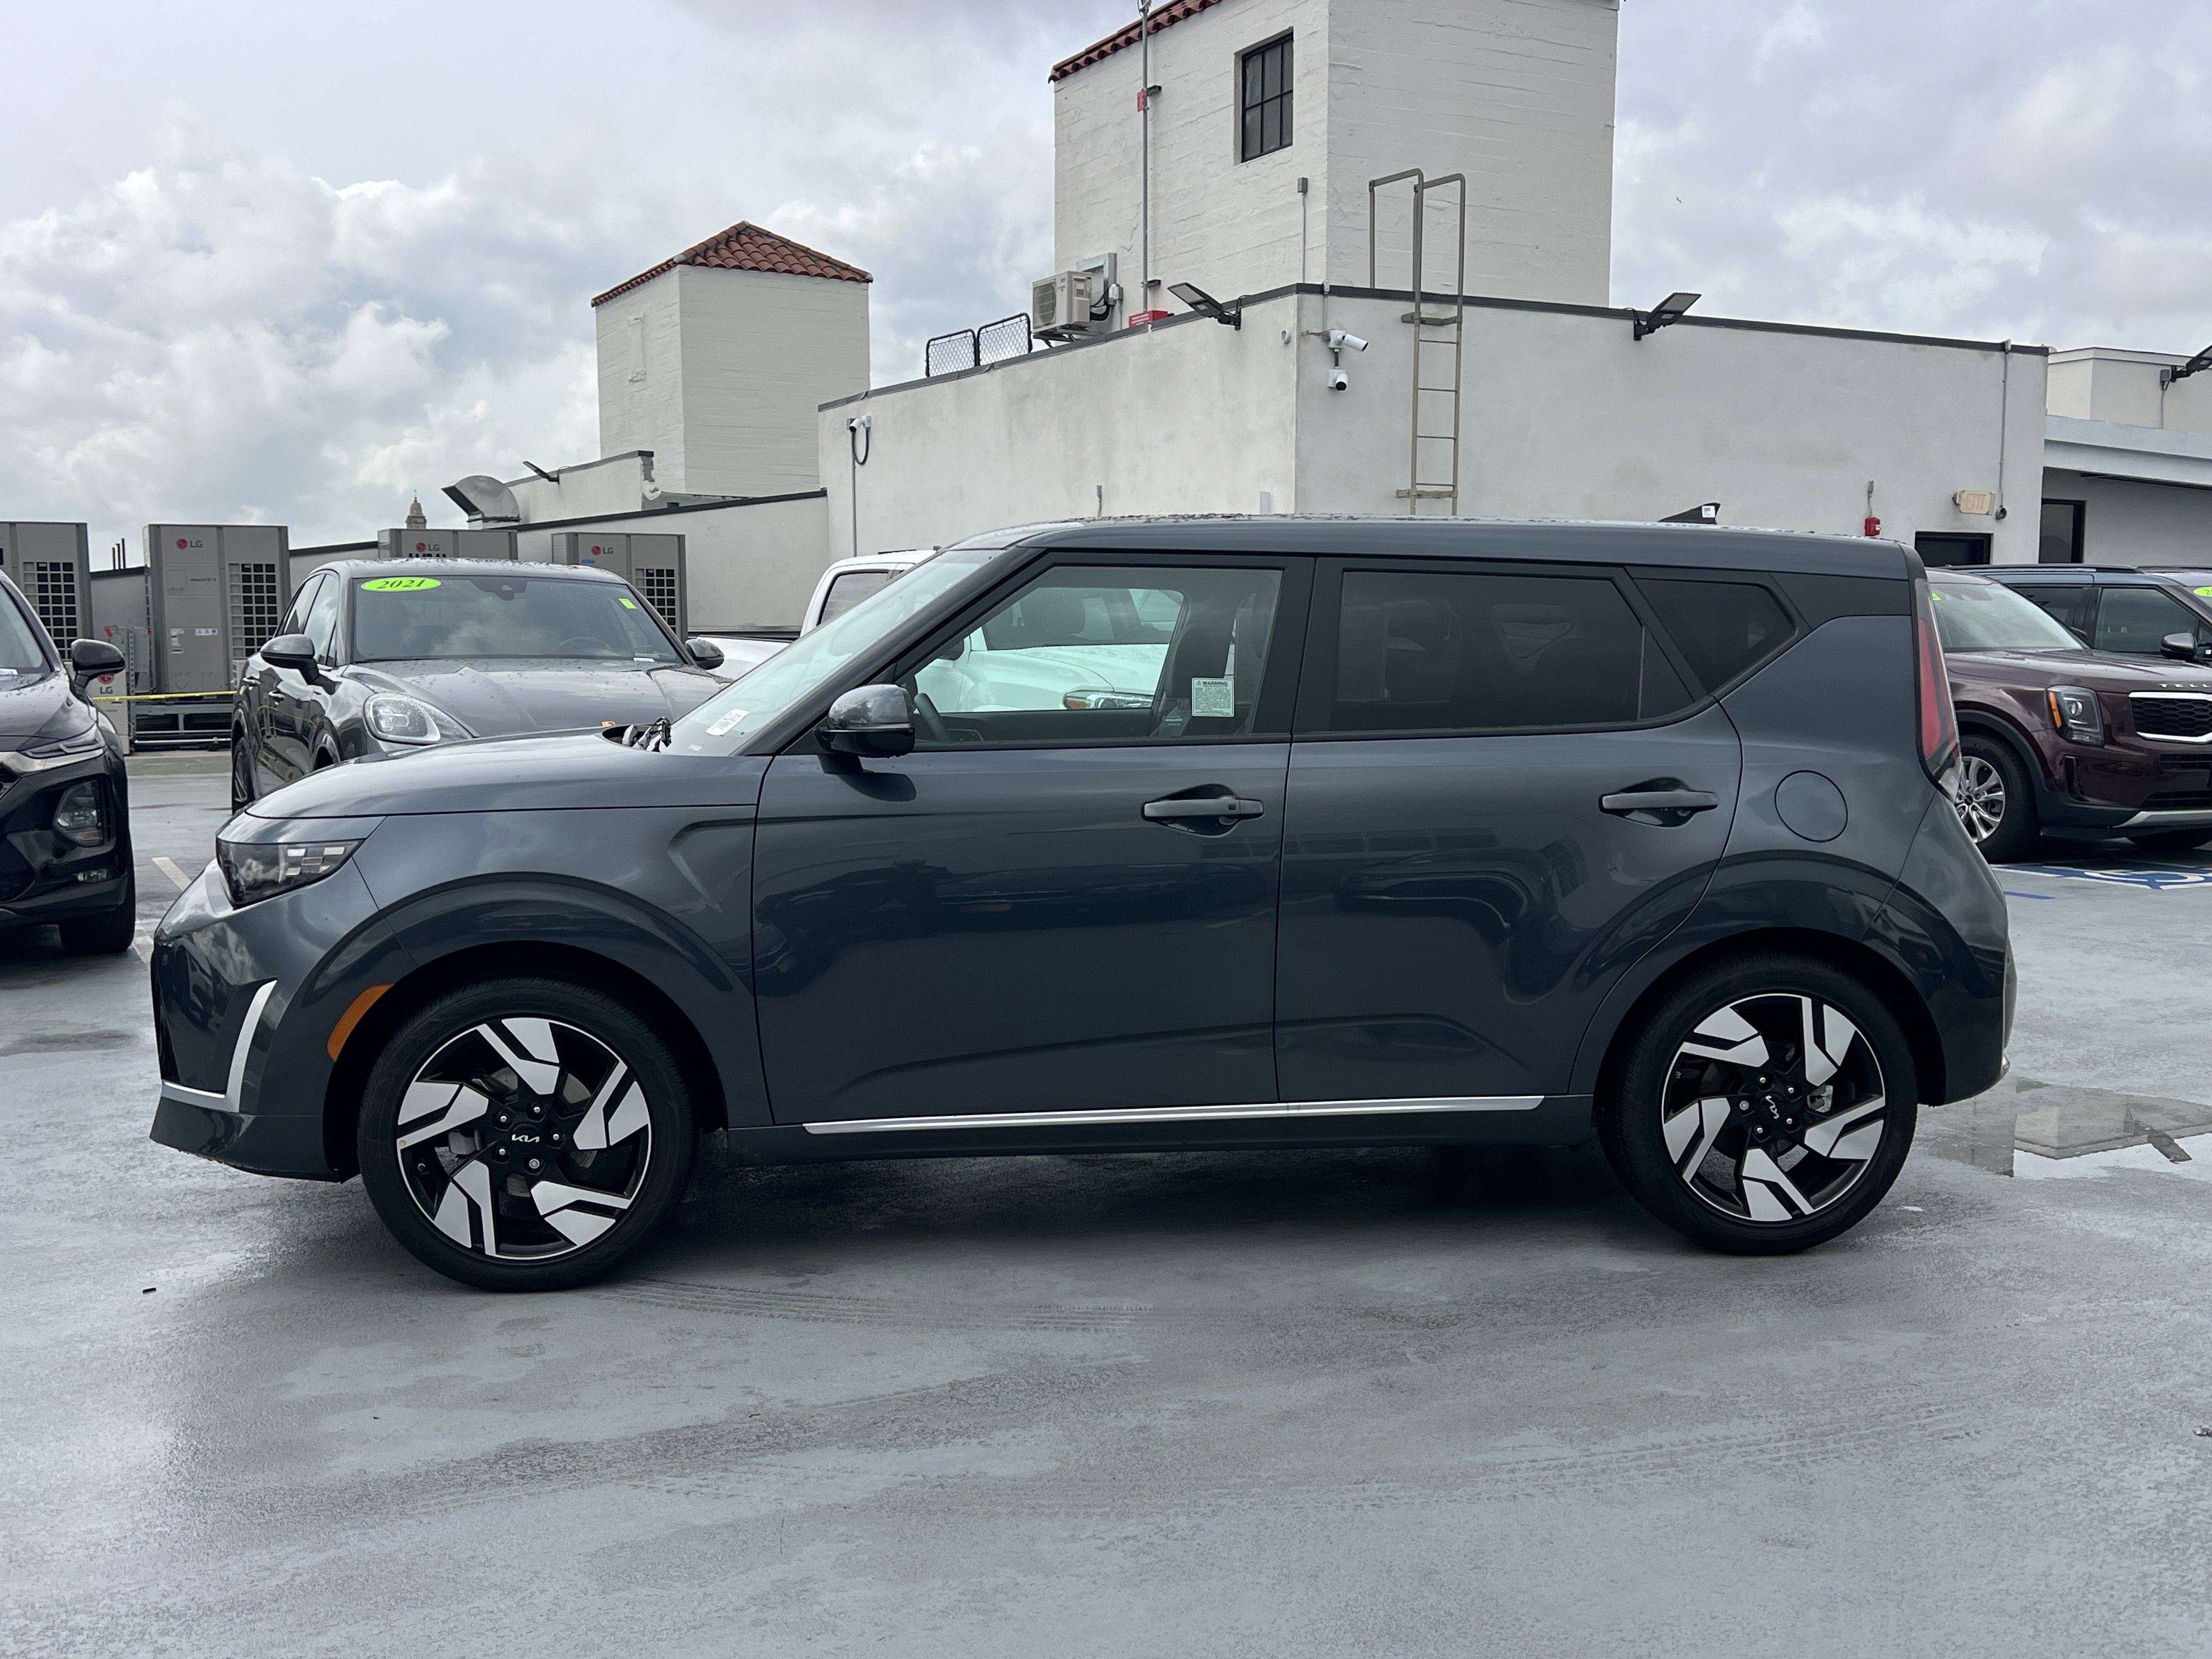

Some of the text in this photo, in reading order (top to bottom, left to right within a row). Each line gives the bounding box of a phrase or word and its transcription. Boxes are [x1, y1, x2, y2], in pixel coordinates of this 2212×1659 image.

[1966, 493, 1987, 511] EXIT
[189, 540, 202, 548] LG
[376, 579, 426, 589] 2021
[511, 1133, 540, 1143] KIA
